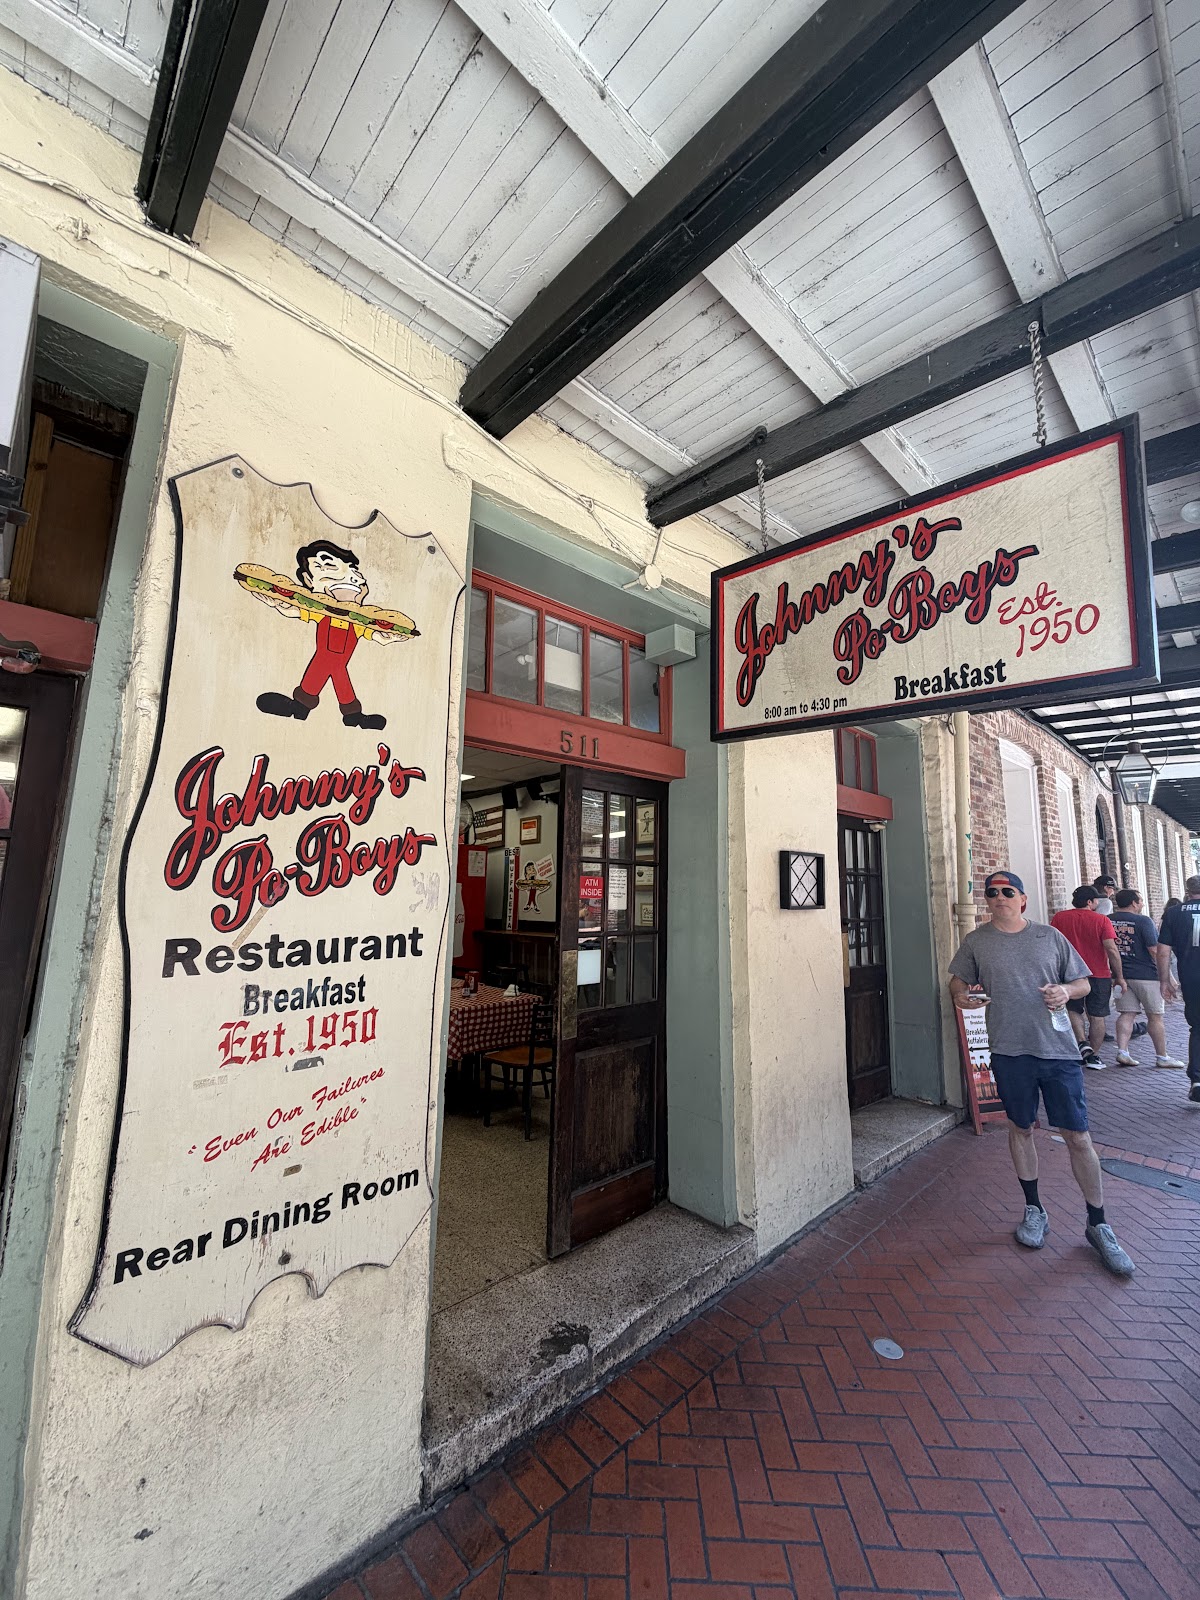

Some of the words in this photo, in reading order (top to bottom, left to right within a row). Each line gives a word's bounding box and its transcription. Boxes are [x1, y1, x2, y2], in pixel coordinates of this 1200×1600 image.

[735, 516, 962, 707] Johnny's
[833, 545, 1039, 685] Po-Boys
[997, 581, 1063, 626] Est.
[1015, 603, 1101, 658] 1950
[893, 659, 1008, 701] Breakfast
[764, 705, 782, 720] 8:00
[784, 705, 797, 717] am
[799, 701, 809, 714] to
[811, 697, 830, 712] 4:30
[833, 697, 848, 712] pm
[560, 730, 600, 760] 511
[164, 743, 427, 891] Johnny's
[211, 813, 438, 933] Po-Boys
[580, 888, 603, 897] INSIDE
[584, 878, 599, 887] ATM
[161, 926, 425, 978] Restaurant
[241, 974, 367, 1016] Breakfast
[218, 1019, 295, 1069] Est.
[303, 1006, 380, 1053] 1950
[266, 1104, 305, 1131] Our
[311, 1066, 387, 1112] Failures
[250, 1141, 292, 1173] Are
[112, 1230, 213, 1285] Rear
[221, 1193, 334, 1250] Dining
[340, 1168, 420, 1210] Room
